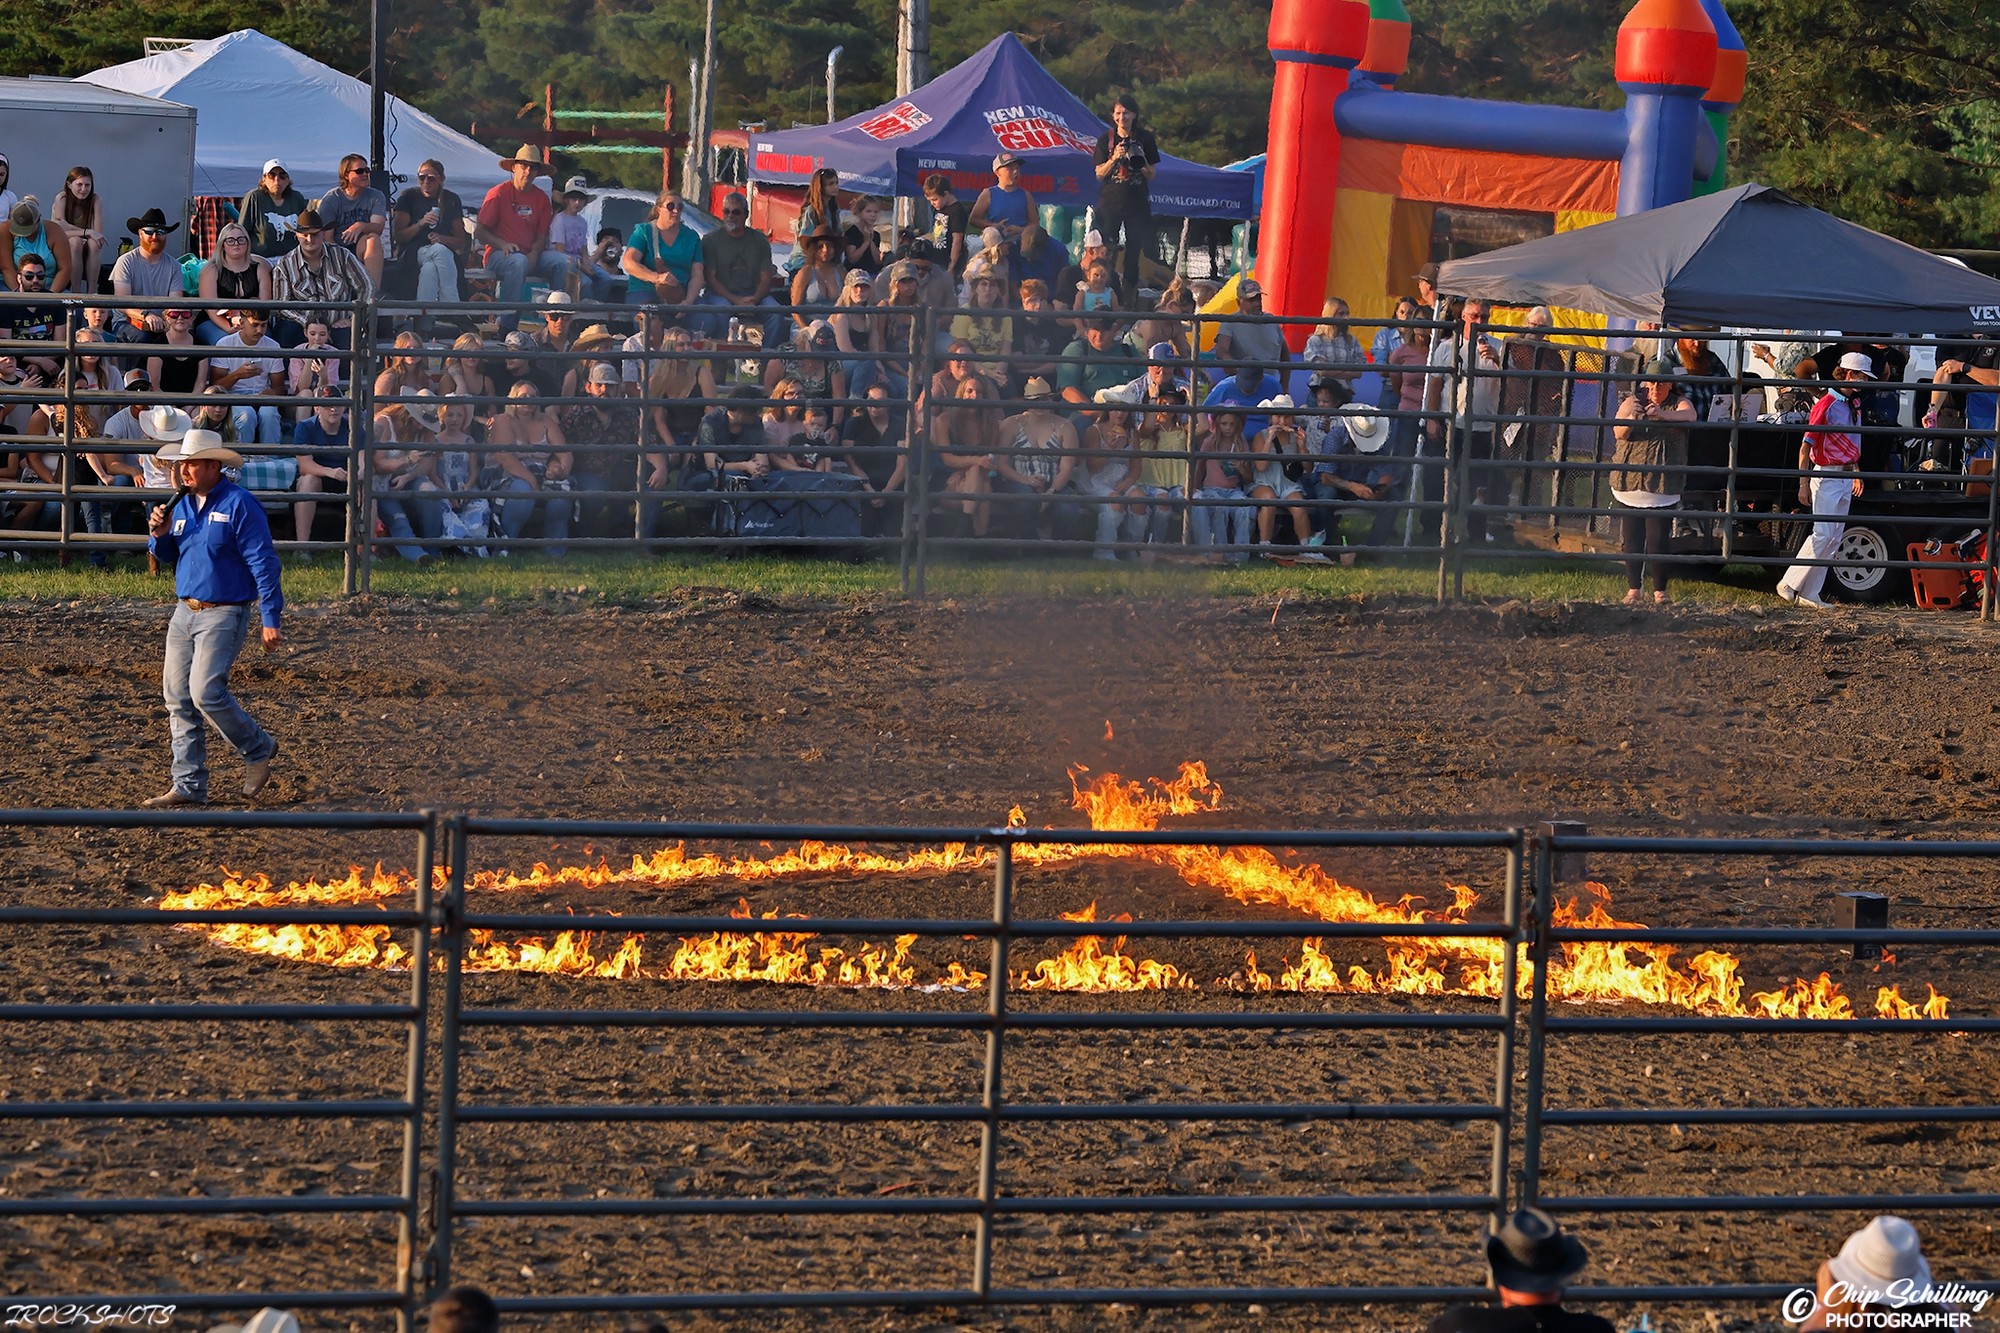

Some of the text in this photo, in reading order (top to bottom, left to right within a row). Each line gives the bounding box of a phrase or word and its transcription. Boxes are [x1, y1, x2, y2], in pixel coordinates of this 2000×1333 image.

[983, 105, 1025, 124] NEW
[991, 117, 1078, 139] NATIO
[998, 130, 1095, 156] GUA
[918, 158, 957, 170] NEW YORK
[1149, 194, 1241, 209] ATIONALGUARD.COM
[15, 314, 53, 327] TEAM
